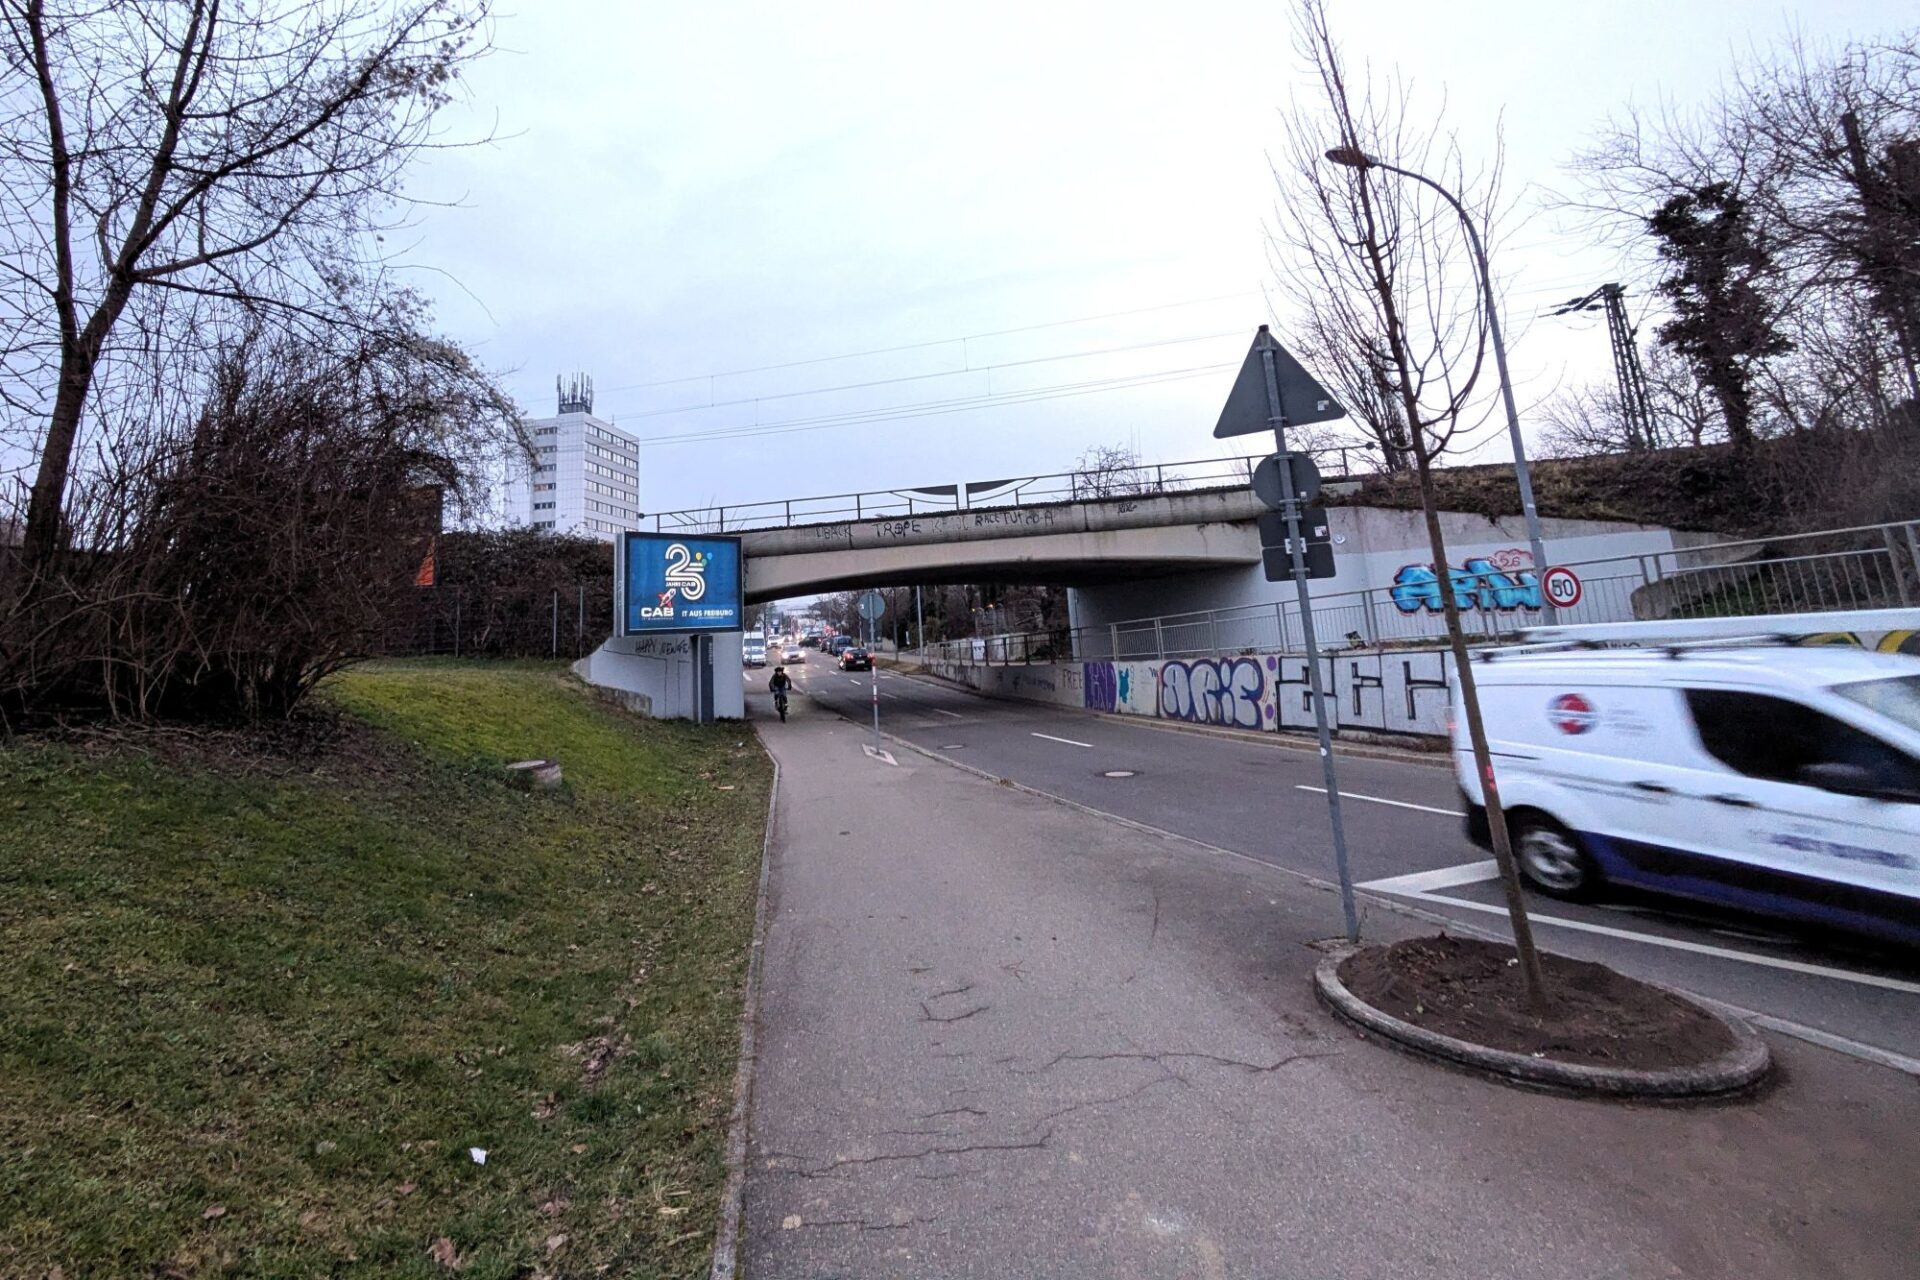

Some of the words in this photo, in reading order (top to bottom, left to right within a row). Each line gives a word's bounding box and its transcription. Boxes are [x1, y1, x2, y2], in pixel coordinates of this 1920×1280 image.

[665, 543, 705, 600] 25
[1551, 578, 1574, 597] 50
[641, 607, 674, 617] CAB
[703, 609, 734, 617] FREIBURG
